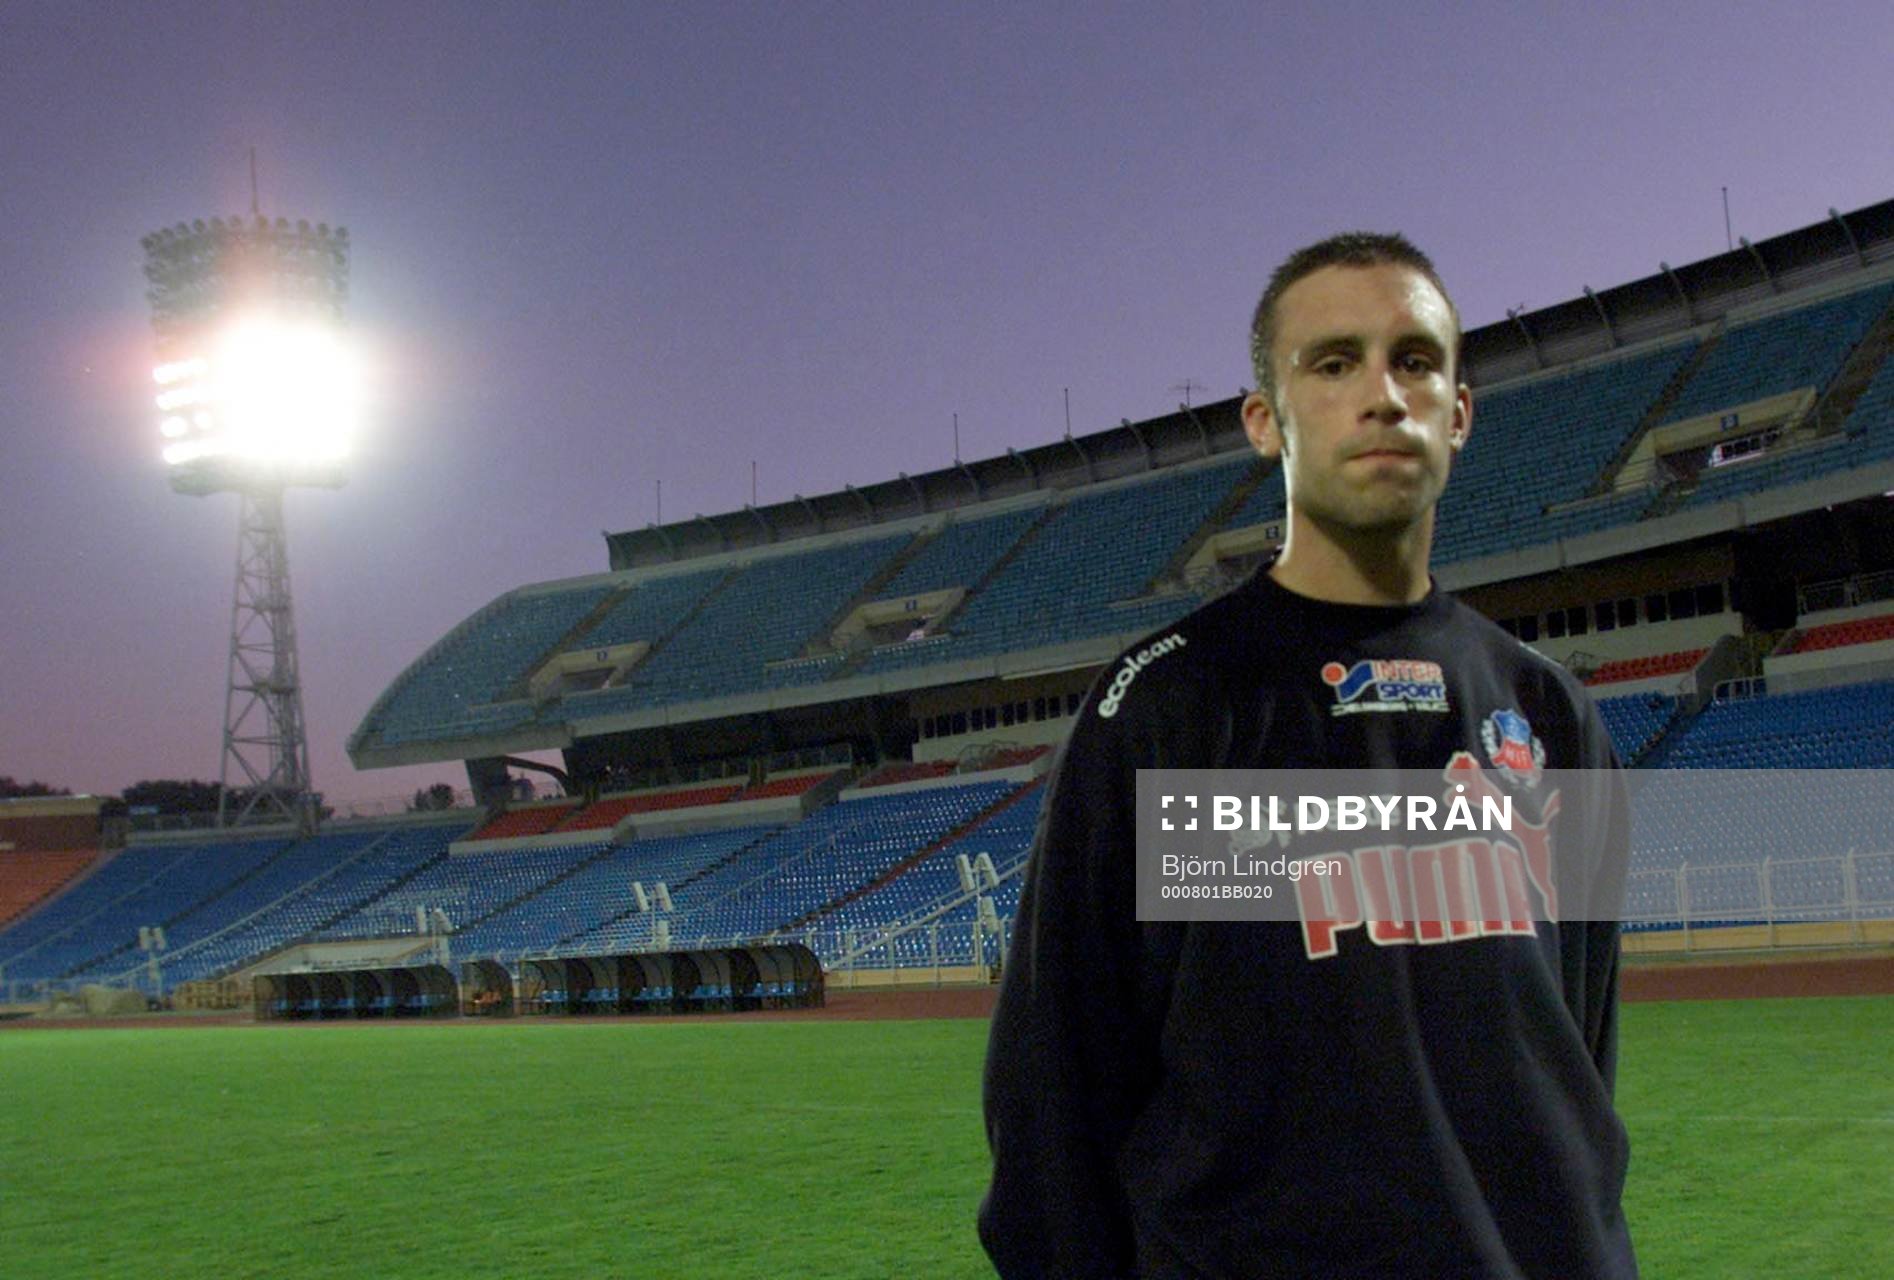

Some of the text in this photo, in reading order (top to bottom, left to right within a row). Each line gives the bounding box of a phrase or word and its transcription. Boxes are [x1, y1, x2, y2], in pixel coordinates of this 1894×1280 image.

[1098, 633, 1187, 718] ecolean
[1374, 660, 1443, 681] INTER
[1379, 683, 1443, 699] SPORT
